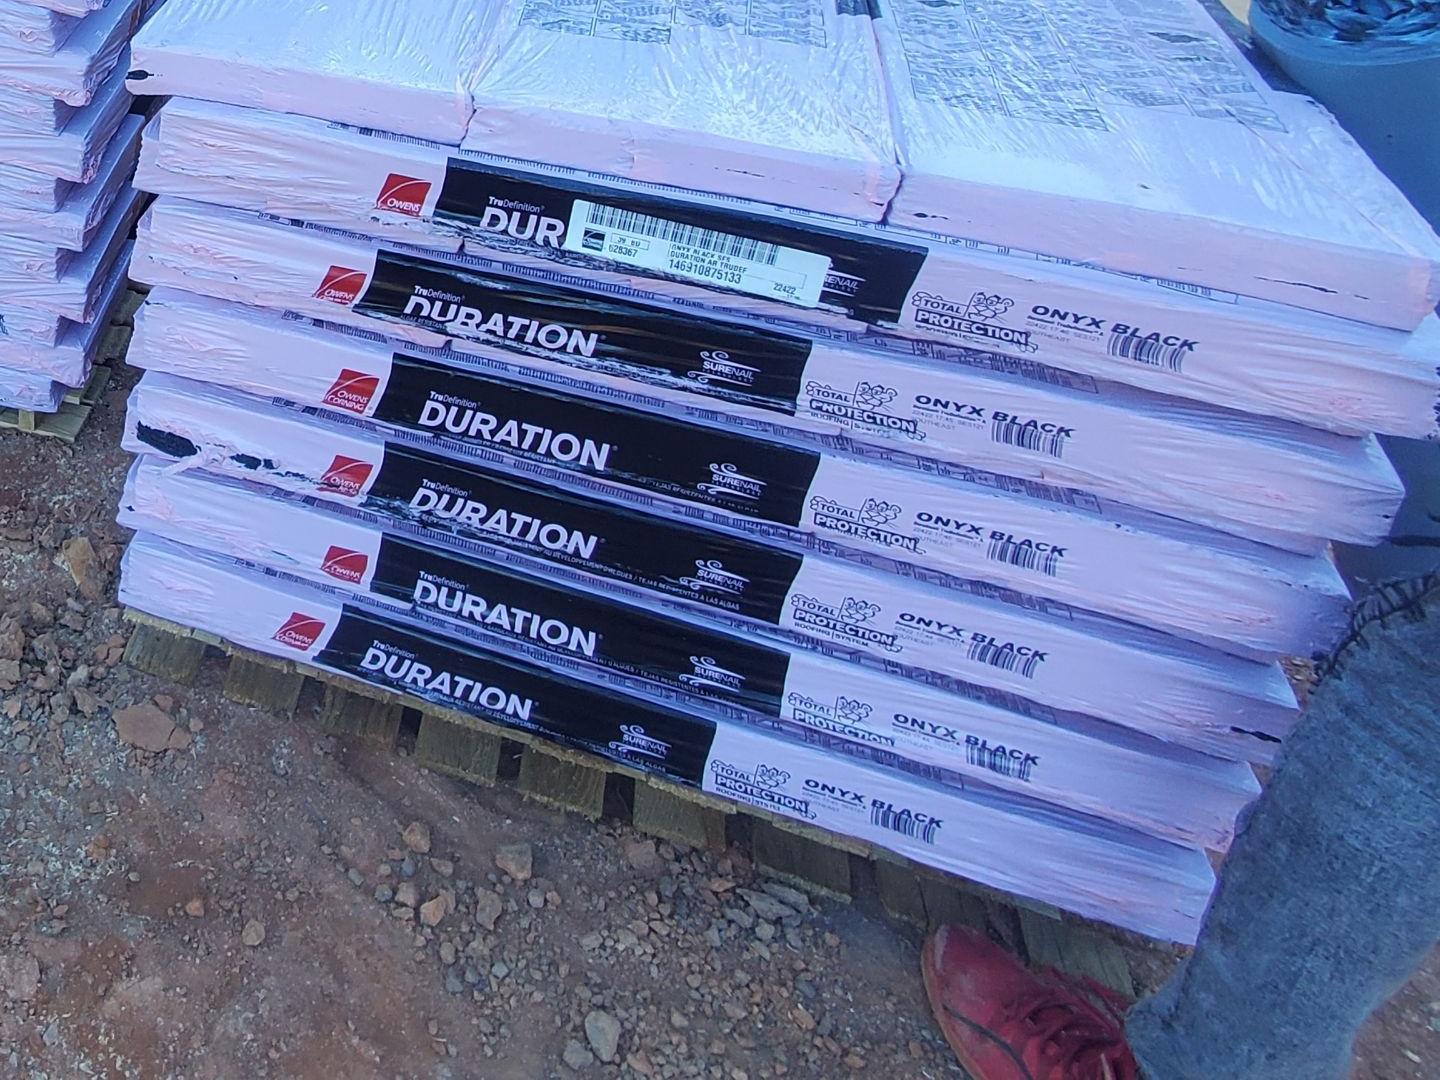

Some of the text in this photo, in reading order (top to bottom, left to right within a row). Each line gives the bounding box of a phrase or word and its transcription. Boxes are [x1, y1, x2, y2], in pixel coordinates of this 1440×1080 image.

[386, 199, 422, 212] OWENS
[488, 196, 545, 214] TruDefinition
[670, 251, 748, 274] DURATION AR TRUDEF
[668, 259, 742, 285] 146910875133
[324, 289, 356, 302] OWENS
[414, 285, 465, 302] TruDefinition
[773, 282, 797, 295] 22422
[923, 299, 961, 314] TOTAL
[404, 296, 599, 356] DURATION
[917, 311, 1027, 344] PROTECTION
[1031, 305, 1106, 329] ONYX
[1111, 323, 1199, 352] BLACK
[702, 360, 754, 380] SURENAIL
[337, 390, 370, 404] OWENS
[430, 391, 480, 407] TruDefinition
[814, 387, 852, 404] TOTAL
[327, 398, 365, 412] CORNING
[809, 401, 916, 434] PROTECTION
[915, 394, 986, 418] ONYX
[992, 411, 1074, 439] BLACK
[418, 400, 611, 472] DURATION
[422, 478, 468, 496] TruDefinition
[713, 474, 762, 492] SURENAIL
[816, 501, 855, 519] TOTAL
[409, 488, 598, 558] DURATION
[813, 515, 917, 552] PROTECTION
[916, 512, 982, 536] ONYX
[990, 529, 1067, 559] BLACK
[331, 566, 360, 578] OWENS
[419, 571, 468, 589] TruDefinition
[697, 572, 744, 591] SURENAIL
[799, 598, 836, 616] TOTAL
[414, 582, 596, 656] DURATION
[287, 630, 314, 642] OWENS
[794, 611, 894, 648] PROTECTION
[898, 612, 1048, 662] ONYX BLACK
[372, 640, 416, 658] TruDefinition
[360, 648, 534, 720] DURATION
[694, 668, 740, 685] SURENAIL
[796, 699, 831, 716] TOTAL
[794, 712, 894, 746] PROTECTION
[622, 736, 666, 753] SURENAIL
[893, 713, 1039, 765] ONYX BLACK
[719, 766, 752, 782] TOTAL
[714, 775, 808, 814] PROTECTION
[804, 778, 942, 828] ONYX BLACK
